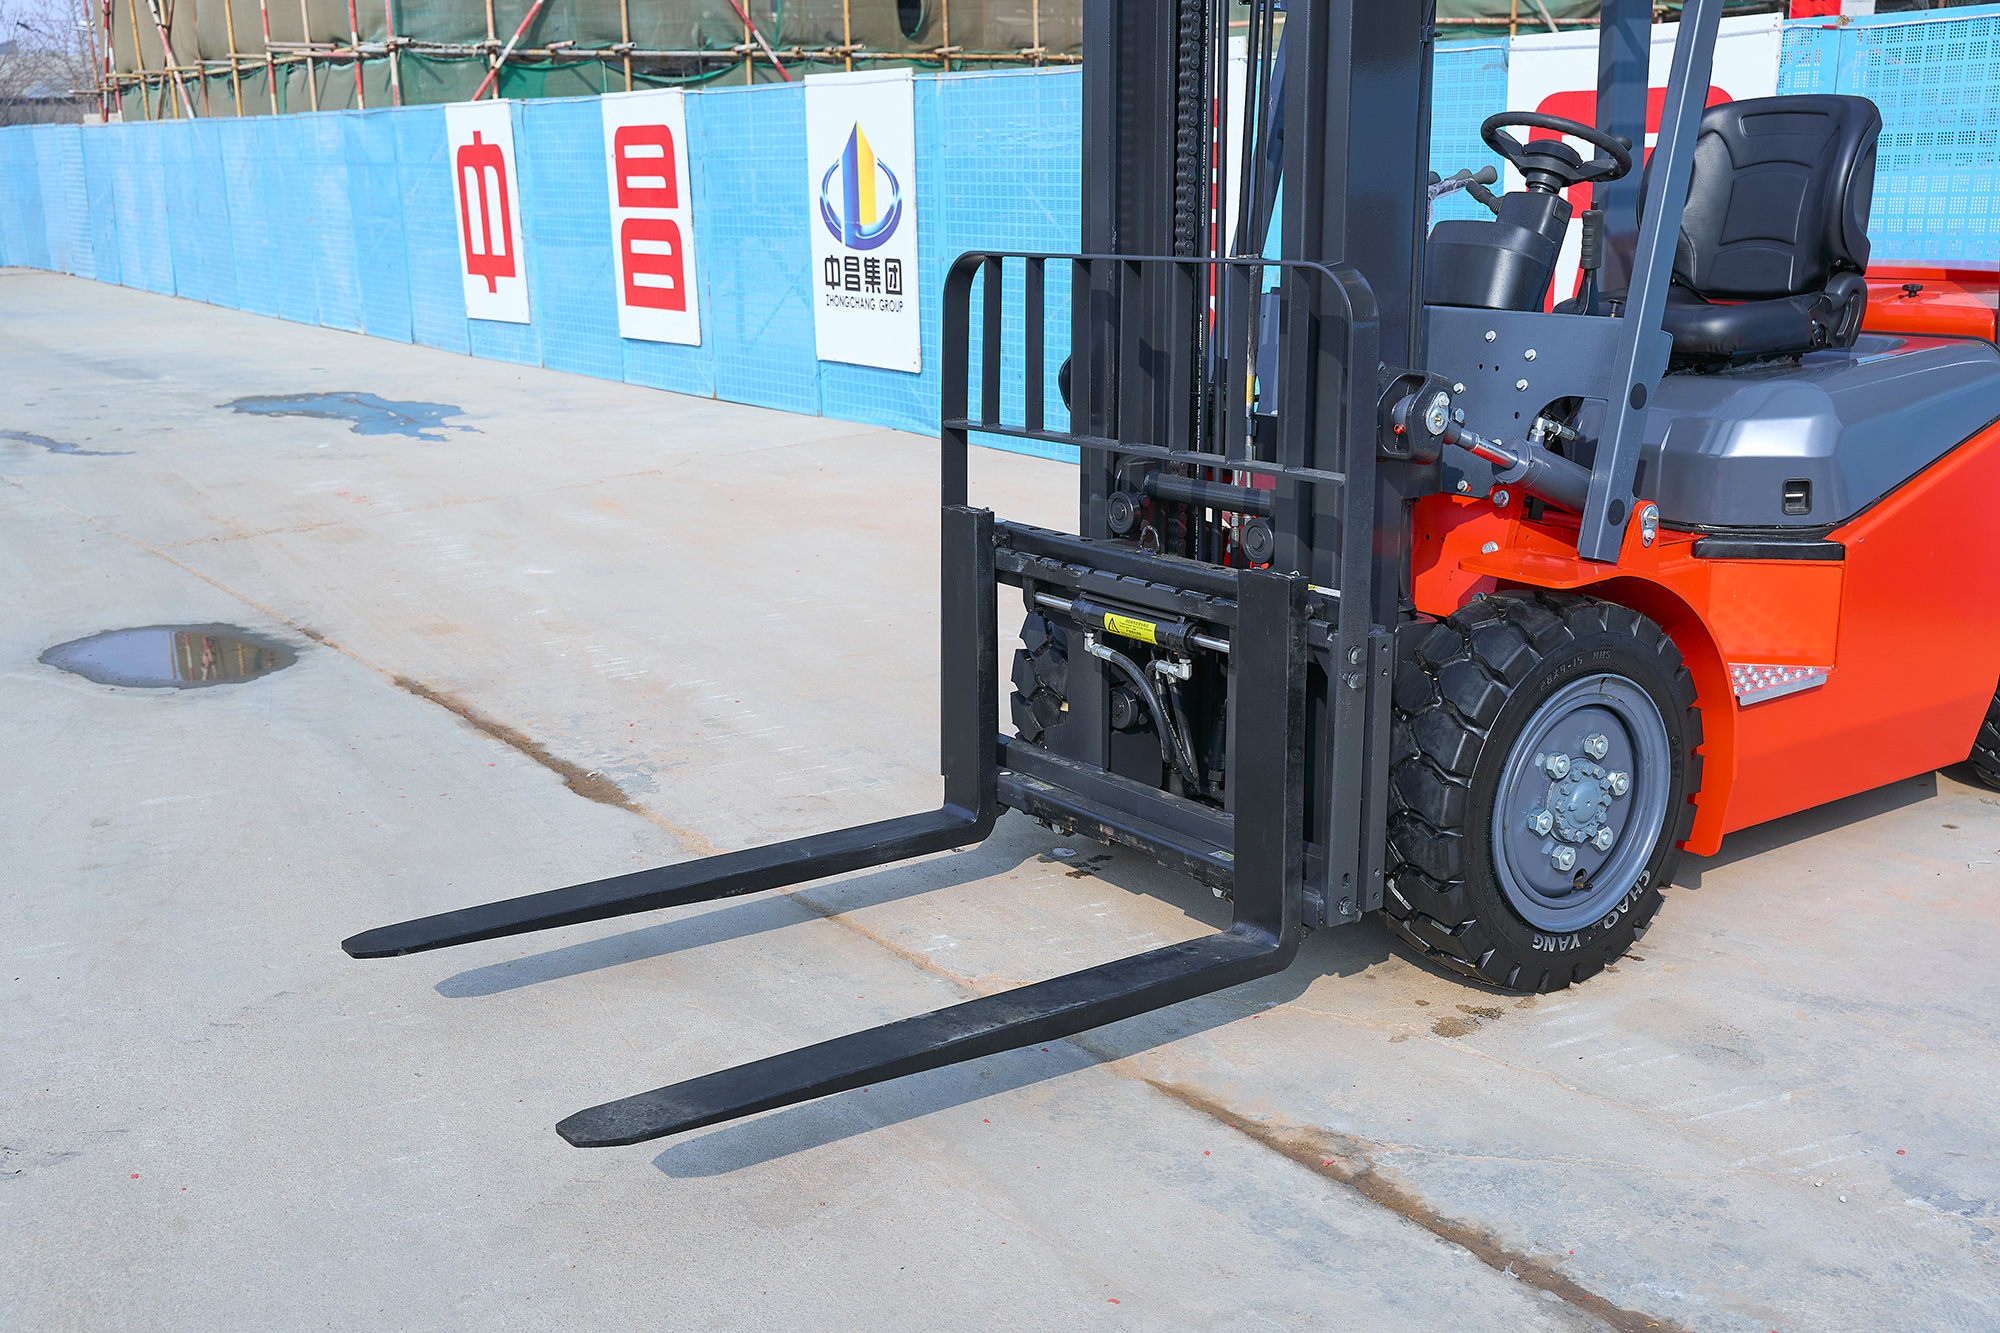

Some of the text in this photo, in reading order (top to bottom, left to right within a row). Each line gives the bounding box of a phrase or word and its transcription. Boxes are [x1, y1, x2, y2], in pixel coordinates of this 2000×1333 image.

[457, 131, 516, 294] 中
[824, 254, 903, 296] 中昌集团
[826, 294, 904, 313] ZHONGCHANG GROUP
[1532, 869, 1651, 952] CHAO YANG
